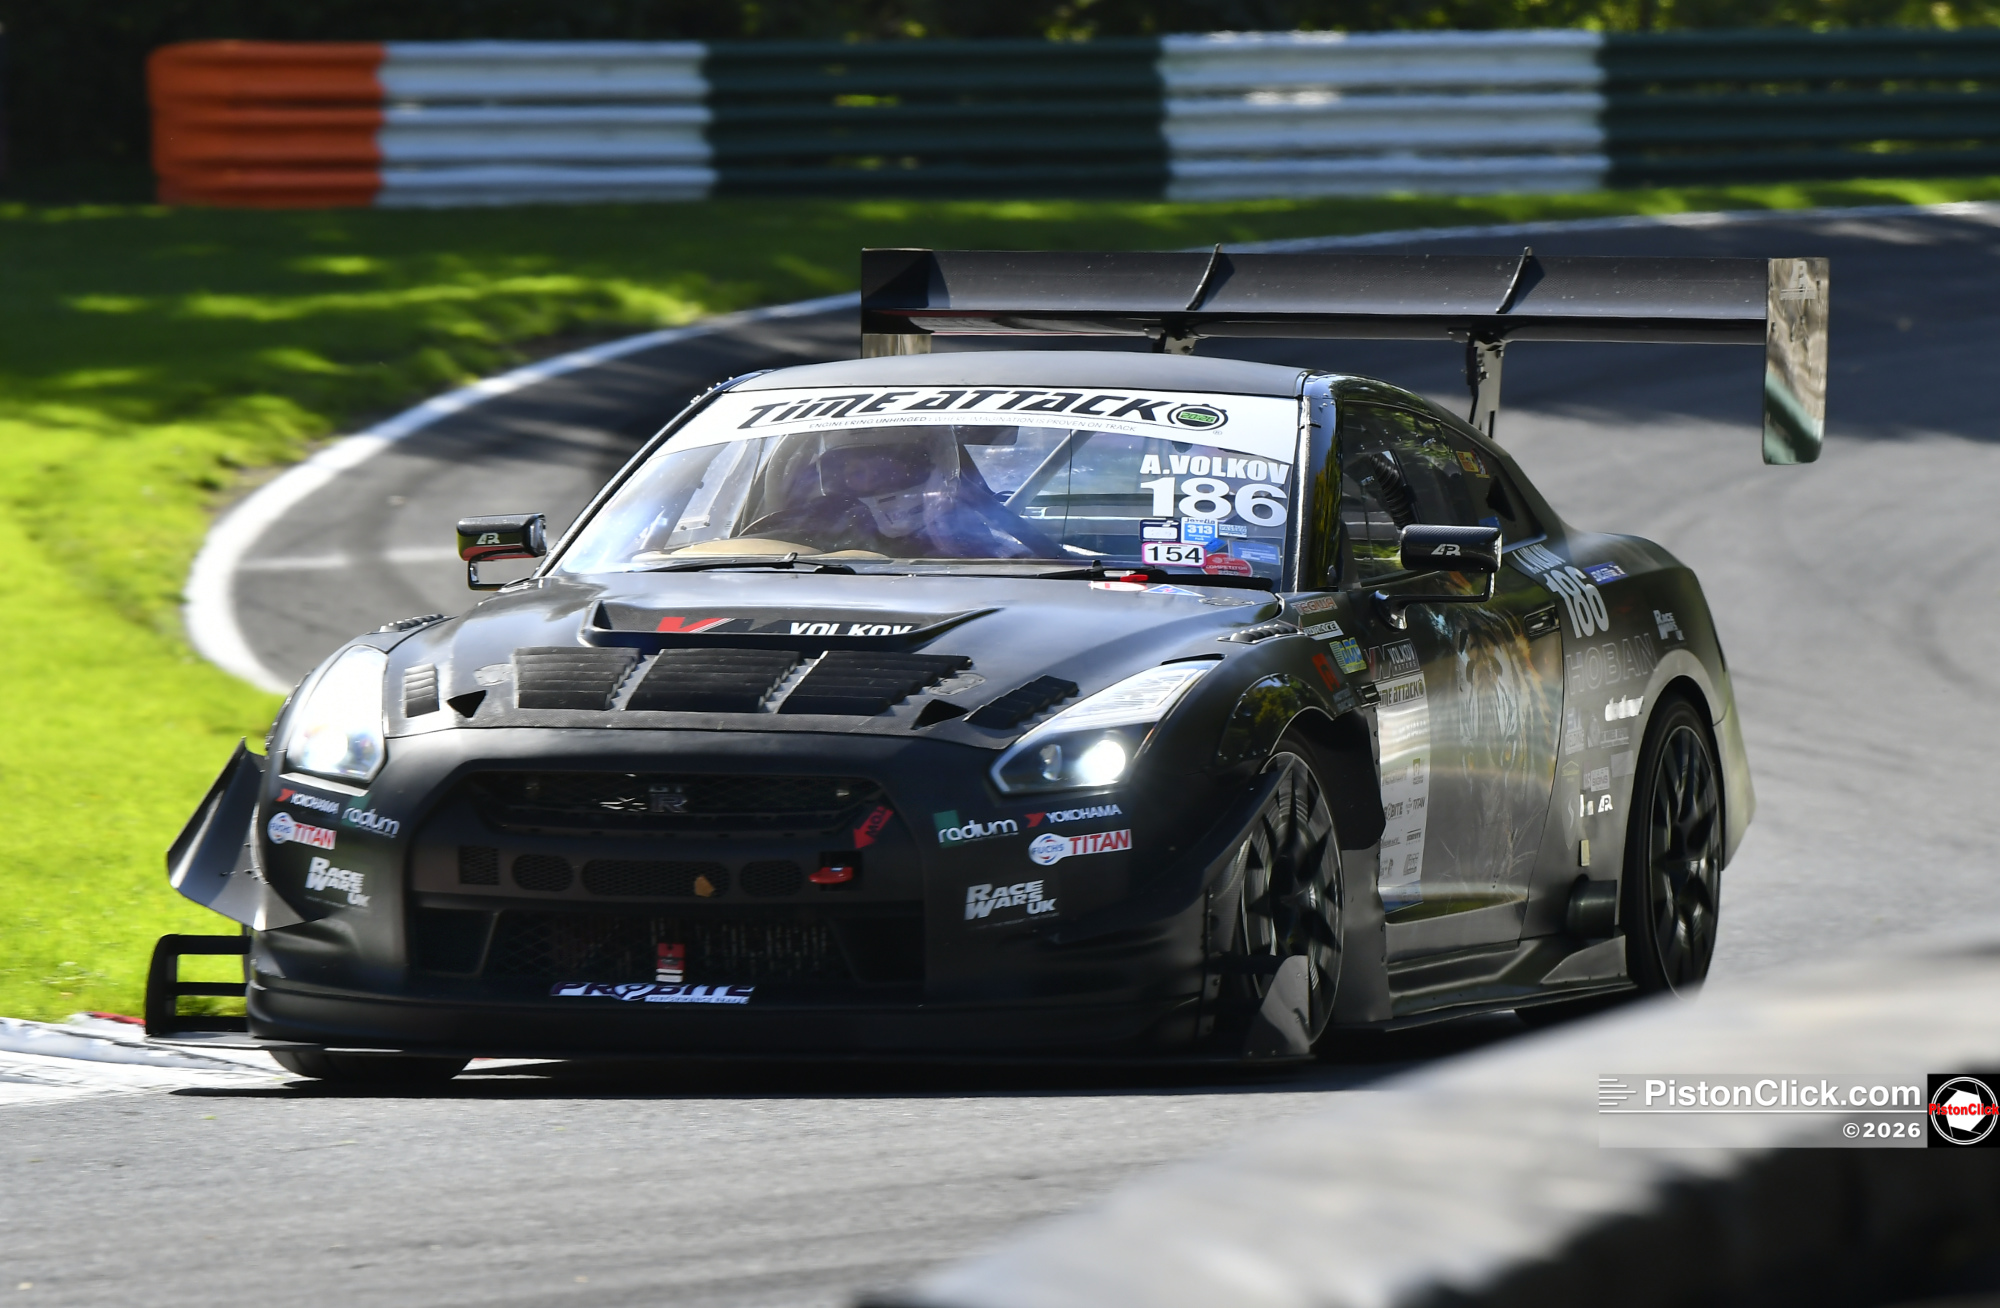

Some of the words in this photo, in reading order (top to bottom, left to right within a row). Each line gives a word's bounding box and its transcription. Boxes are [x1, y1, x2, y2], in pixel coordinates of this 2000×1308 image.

[902, 390, 1175, 421] ATTACK
[809, 418, 874, 429] ENGINEERING
[876, 416, 927, 424] UNHINGED
[969, 416, 1034, 424] IMAGINATION
[1046, 418, 1086, 427] PROVEN
[1105, 423, 1137, 432] TRACK
[1140, 454, 1289, 484] A.VOLKOV
[1140, 477, 1288, 527] 186
[1187, 524, 1214, 535] 313
[1147, 545, 1203, 564] 154
[1543, 566, 1609, 639] 186
[1565, 632, 1659, 695] HOBAN
[290, 792, 340, 815] YOKOHAMA
[1046, 804, 1122, 823] YOKOHAMA
[294, 823, 337, 849] TITAN
[938, 819, 1018, 843] radium
[1031, 843, 1065, 854] FUCHS
[1069, 829, 1131, 855] TITAN
[309, 856, 365, 883] RACE
[305, 872, 363, 893] WARS
[966, 880, 1044, 903] RACE
[347, 892, 371, 907] UK
[964, 891, 1043, 920] WARS
[1027, 898, 1057, 915] UK
